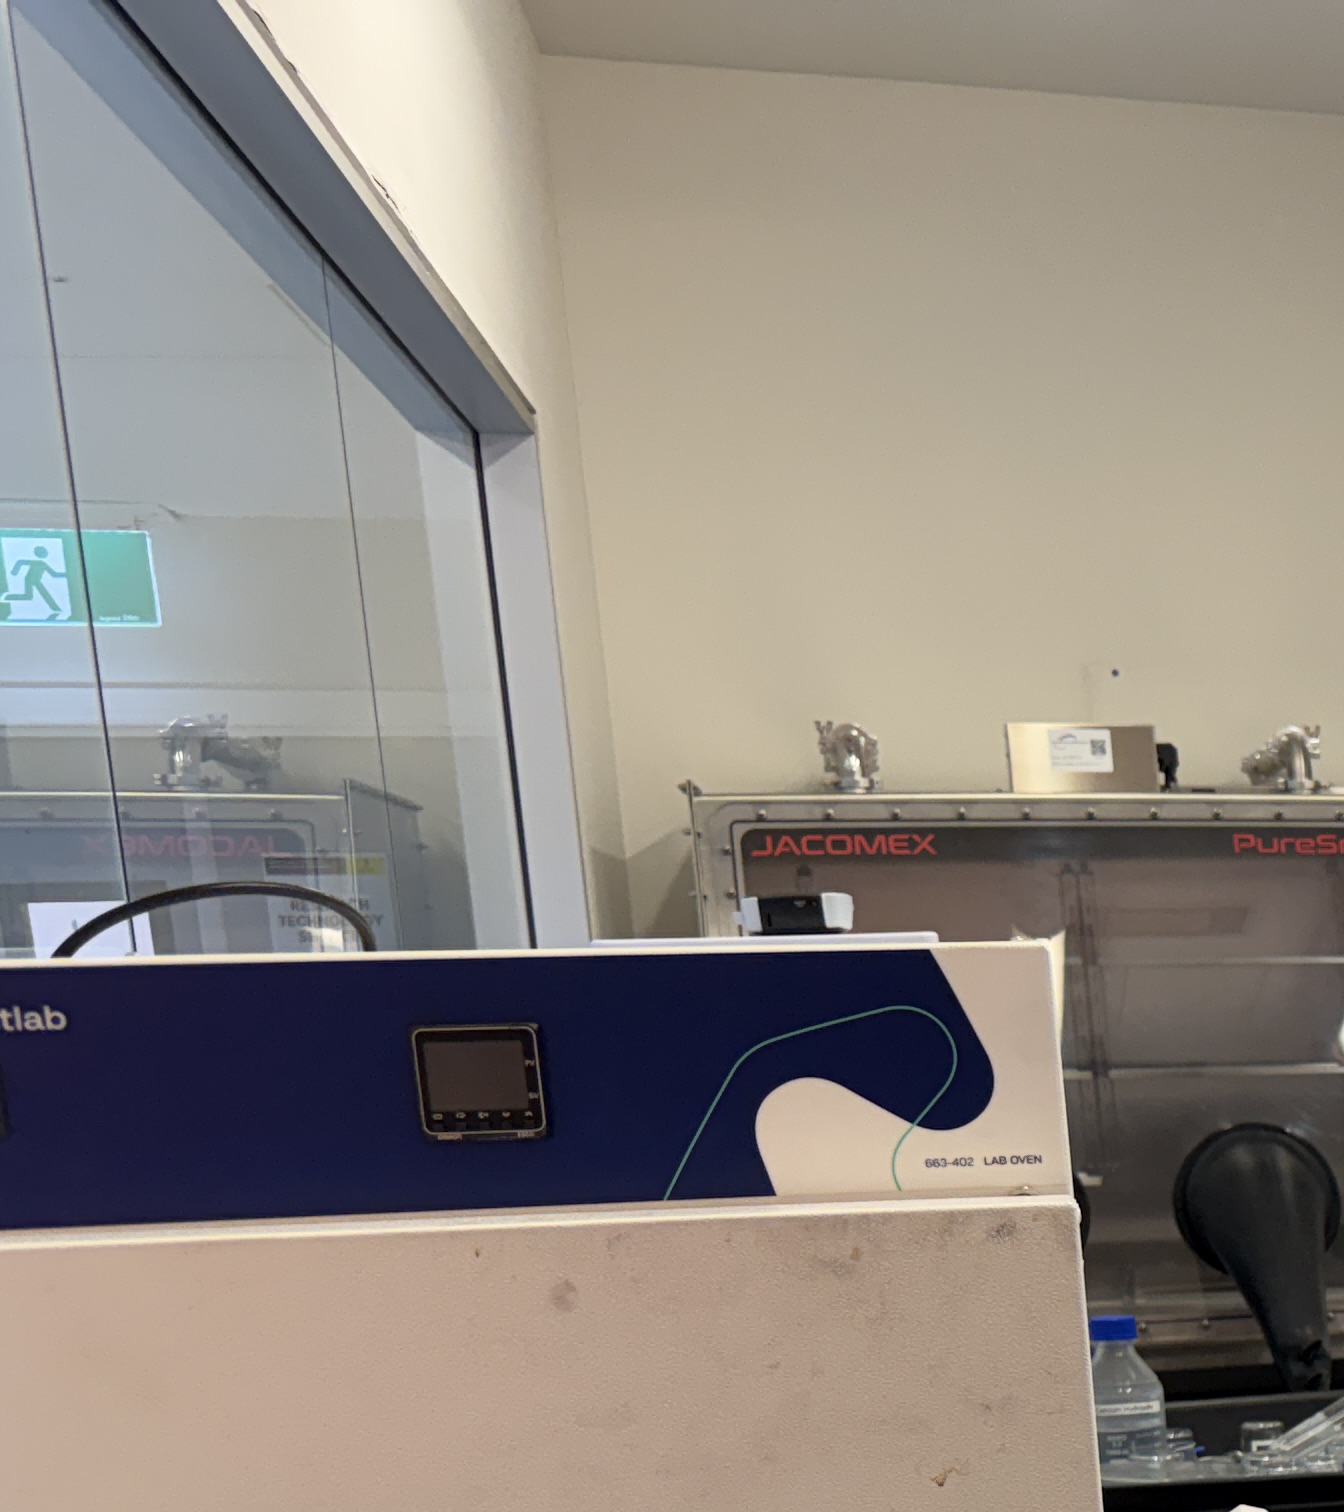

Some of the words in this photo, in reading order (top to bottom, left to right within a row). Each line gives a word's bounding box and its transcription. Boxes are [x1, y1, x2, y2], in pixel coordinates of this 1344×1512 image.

[751, 833, 937, 857] JACOMEX
[924, 1157, 975, 1168] 663-402
[984, 1156, 1008, 1166] LAB
[1010, 1154, 1043, 1165] OVEN
